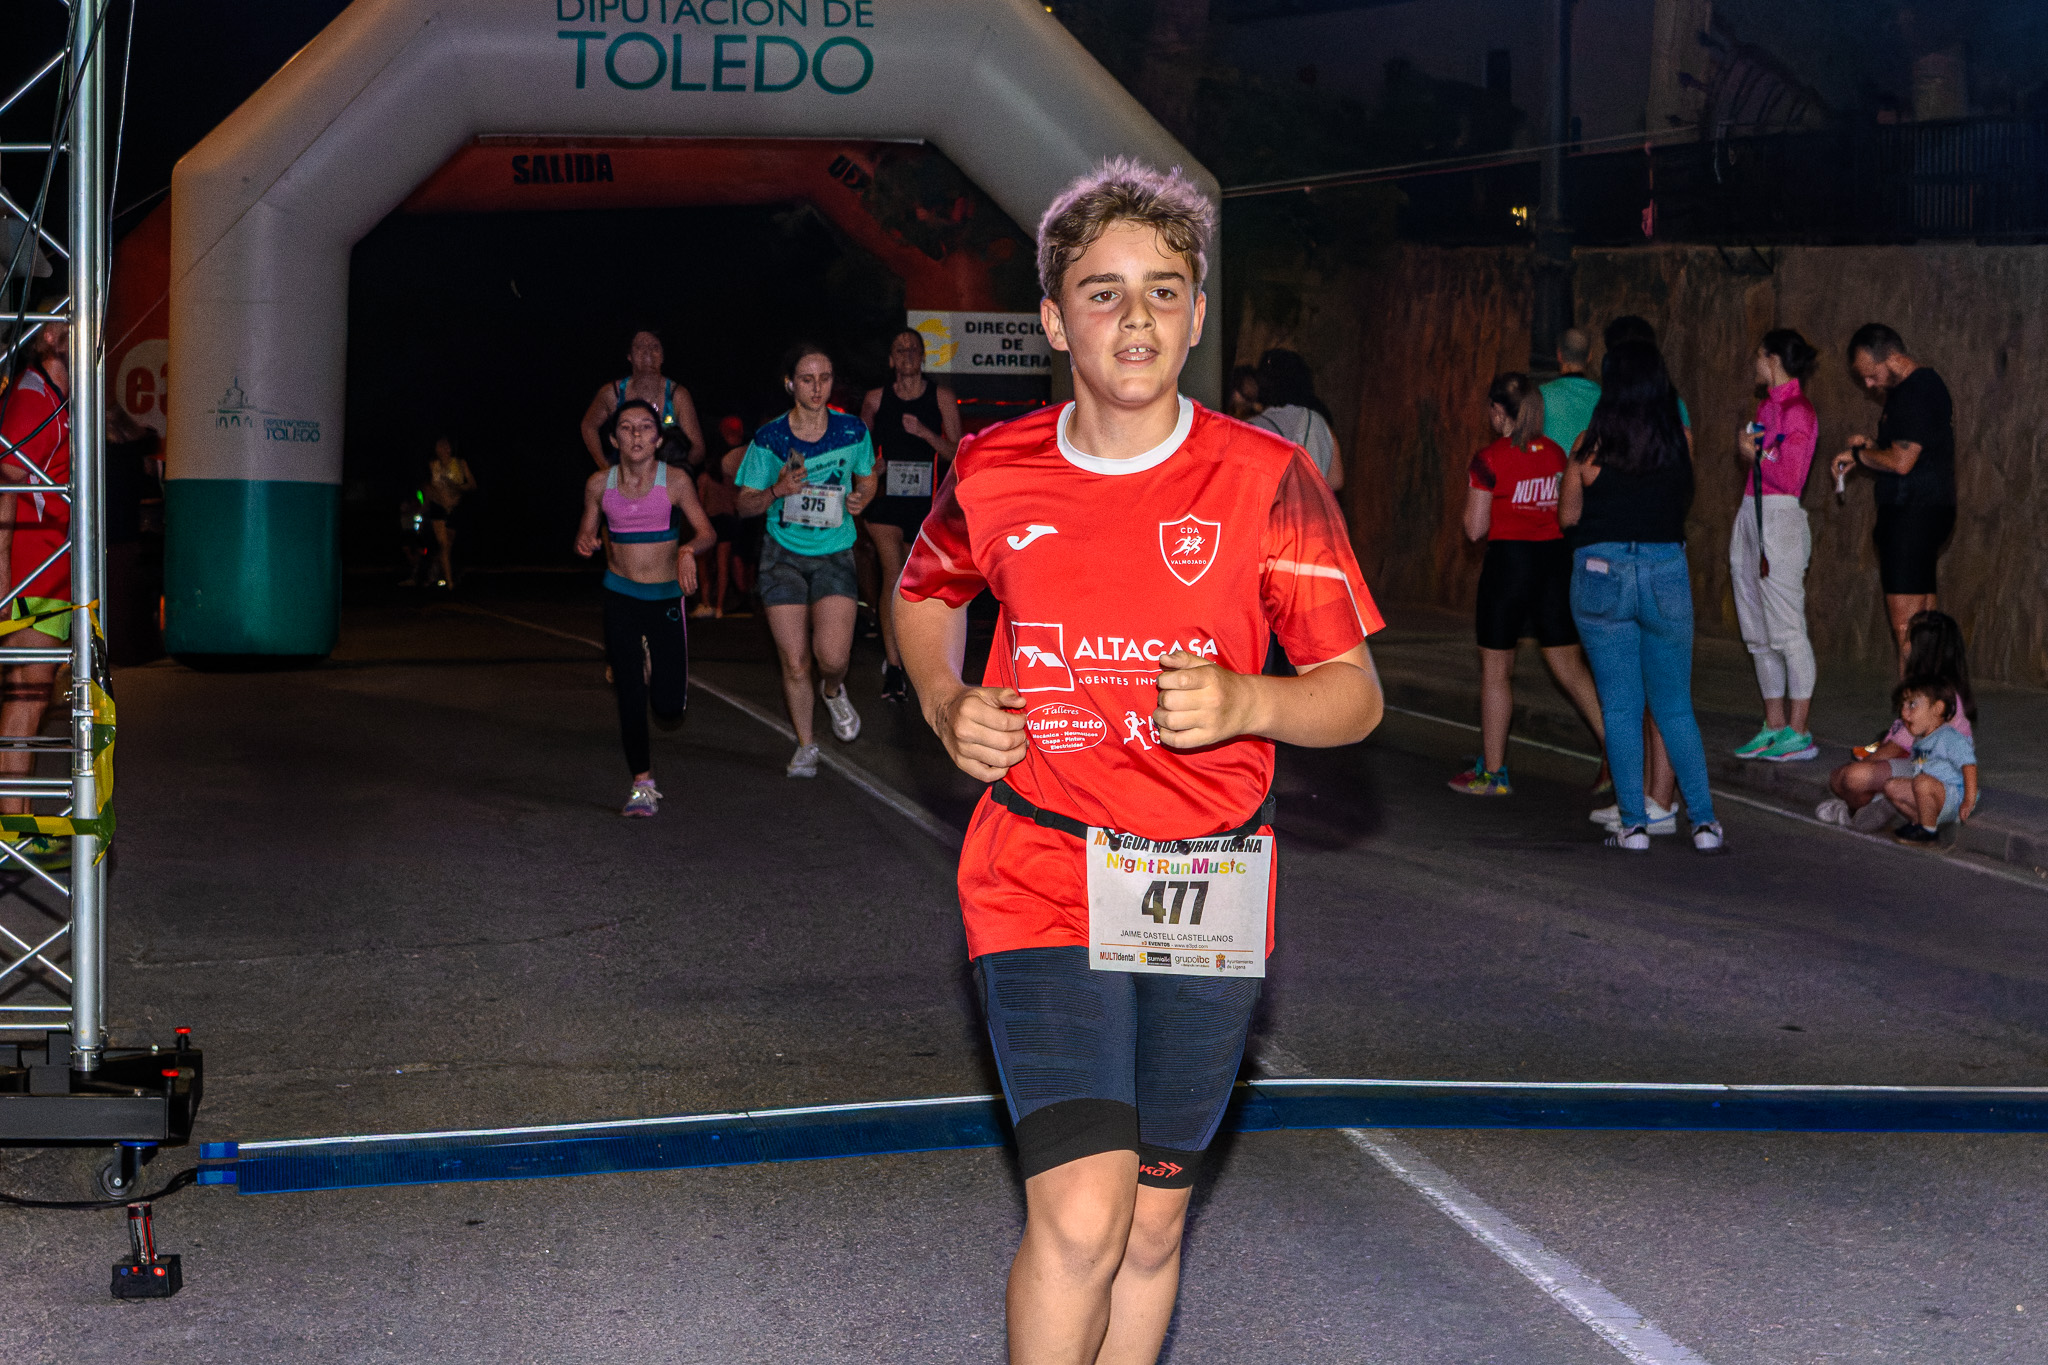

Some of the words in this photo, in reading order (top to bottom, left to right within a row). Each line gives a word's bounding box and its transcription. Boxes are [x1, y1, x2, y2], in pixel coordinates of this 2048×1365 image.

[824, 0, 875, 28] DE
[557, 30, 875, 95] TOLEDO
[511, 152, 614, 184] SALIDA
[965, 321, 1047, 335] DIRECCIO
[1002, 338, 1023, 351] DE
[972, 353, 1051, 367] CARRERA
[801, 496, 826, 512] 375
[1078, 675, 1129, 686] AGENTES
[1042, 705, 1079, 716] Talleres
[1027, 718, 1069, 731] Valmo
[1071, 718, 1103, 730] auto
[1141, 880, 1210, 925] 477
[1120, 930, 1142, 939] JAIME
[1143, 931, 1176, 941] CASTELL
[1176, 933, 1234, 943] CASTELLANOS
[1100, 951, 1136, 962] MULTIdental
